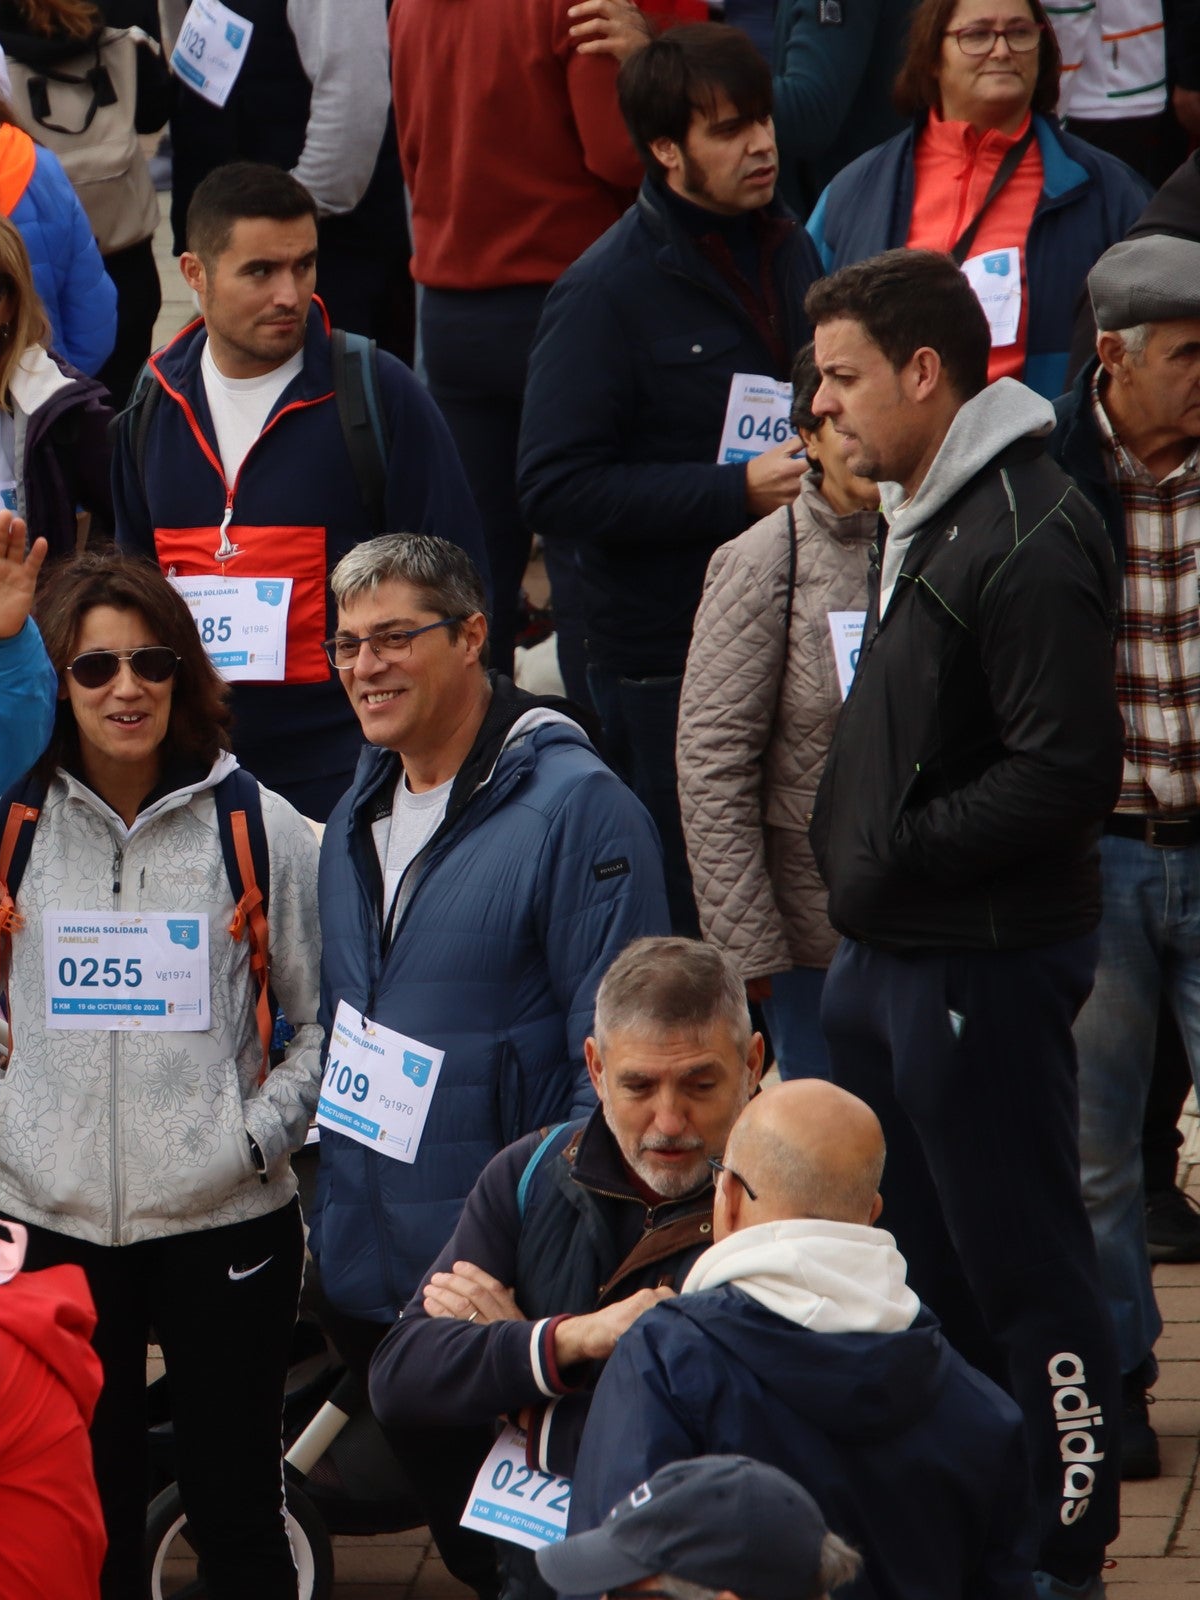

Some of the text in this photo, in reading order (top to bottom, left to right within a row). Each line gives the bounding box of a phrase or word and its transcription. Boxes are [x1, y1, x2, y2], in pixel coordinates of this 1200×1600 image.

[179, 588, 240, 598] ARCHA SOLIDARIA
[58, 936, 99, 944] FAMILIAR
[63, 926, 101, 934] MARCHA
[102, 926, 148, 935] SOLIDARIA
[58, 957, 142, 988] 0255
[156, 970, 191, 981] Vg1974
[97, 1003, 132, 1011] OCTUBRE
[133, 1003, 142, 1011] de
[352, 1033, 385, 1056] SOLIDARIA
[378, 1094, 414, 1116] Pg1970
[325, 1106, 353, 1124] OCTUBRE
[353, 1118, 360, 1128] de
[361, 1121, 374, 1133] 2024
[1048, 1352, 1104, 1526] adidas
[491, 1459, 574, 1513] 0272
[479, 1506, 489, 1515] KM
[495, 1509, 502, 1519] 19
[502, 1511, 510, 1521] de
[511, 1515, 545, 1534] OCTUBRE
[545, 1527, 555, 1536] de
